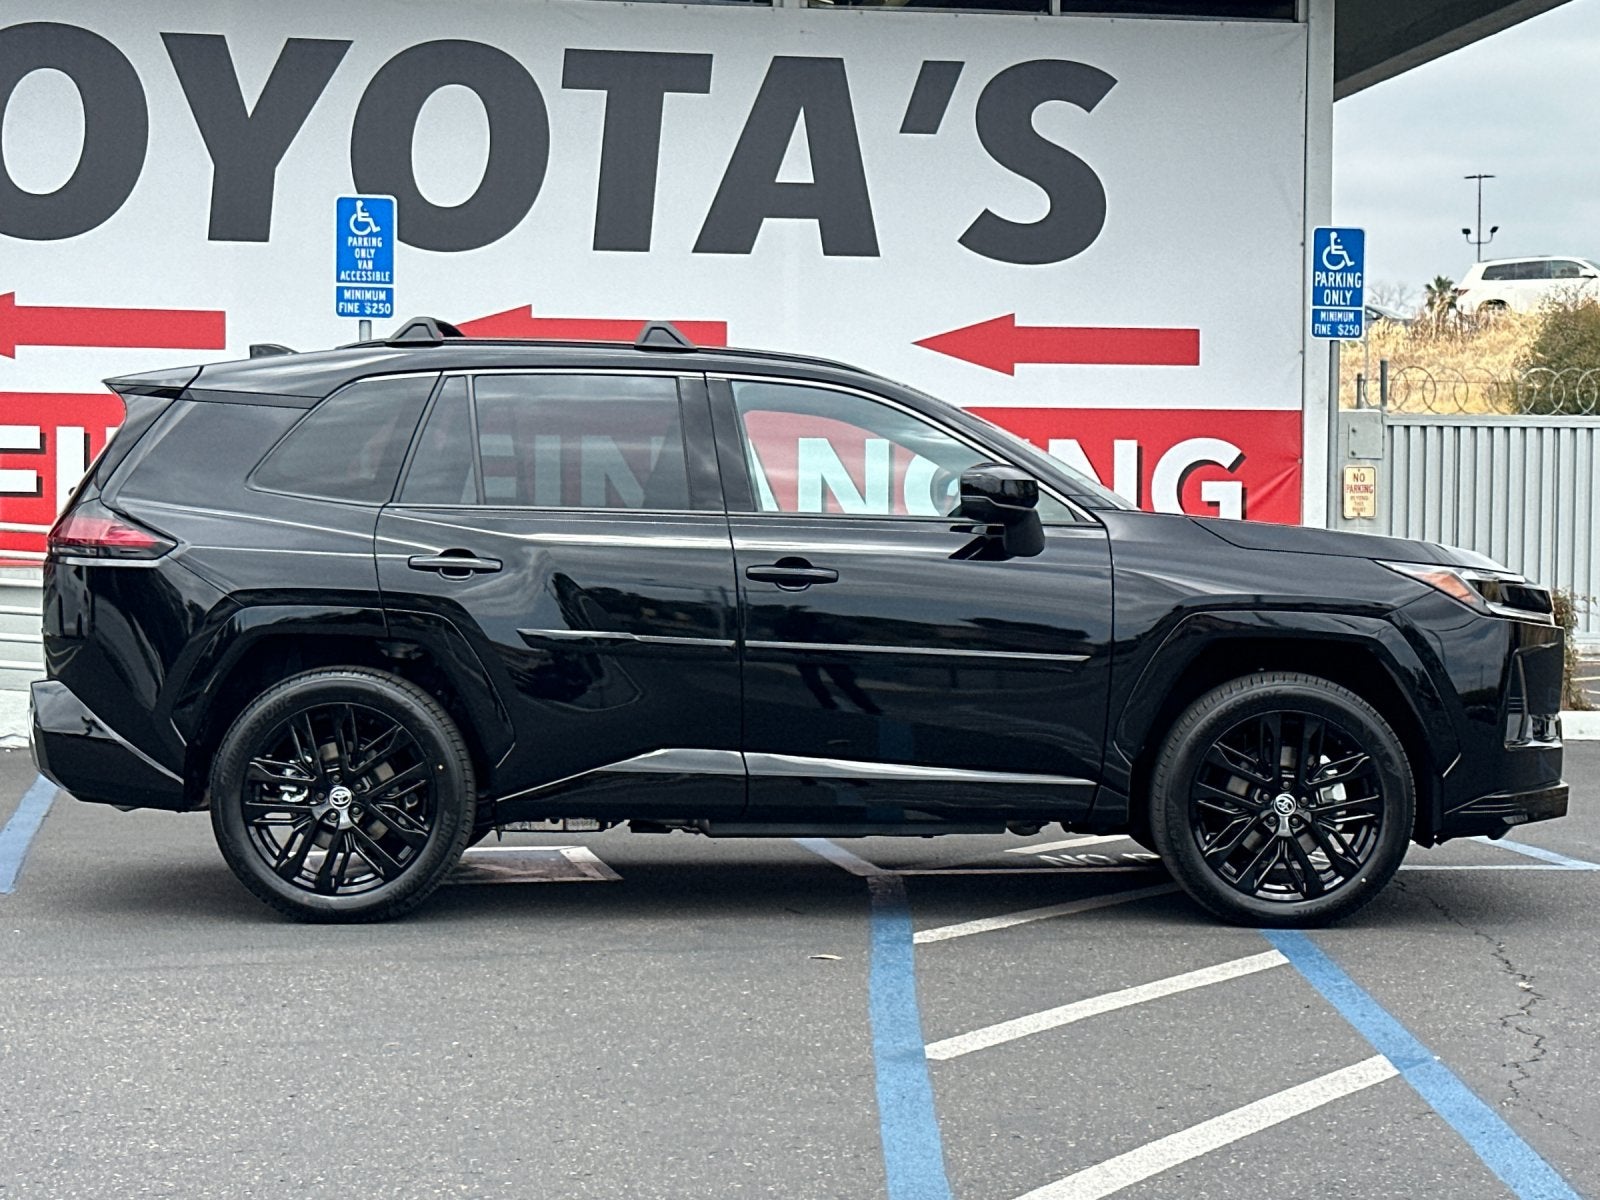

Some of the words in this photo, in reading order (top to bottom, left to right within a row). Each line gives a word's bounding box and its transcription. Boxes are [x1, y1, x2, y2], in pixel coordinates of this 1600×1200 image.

[0, 22, 1118, 265] OYOTA'S
[347, 236, 383, 248] PARKING
[354, 248, 376, 259] ONLY
[357, 260, 373, 270] VAN
[340, 271, 391, 282] ACCESSIBLE
[1314, 271, 1362, 288] PARKING
[343, 289, 387, 301] MINIMUM
[1323, 289, 1353, 306] ONLY
[338, 302, 360, 314] FINE
[364, 302, 391, 315] $250
[1320, 311, 1355, 322] MINIMUM
[1314, 323, 1332, 335] FINE
[1337, 324, 1360, 336] $250
[460, 433, 1243, 521] FINNNG
[1353, 473, 1366, 482] NO
[1346, 484, 1373, 494] PARKING
